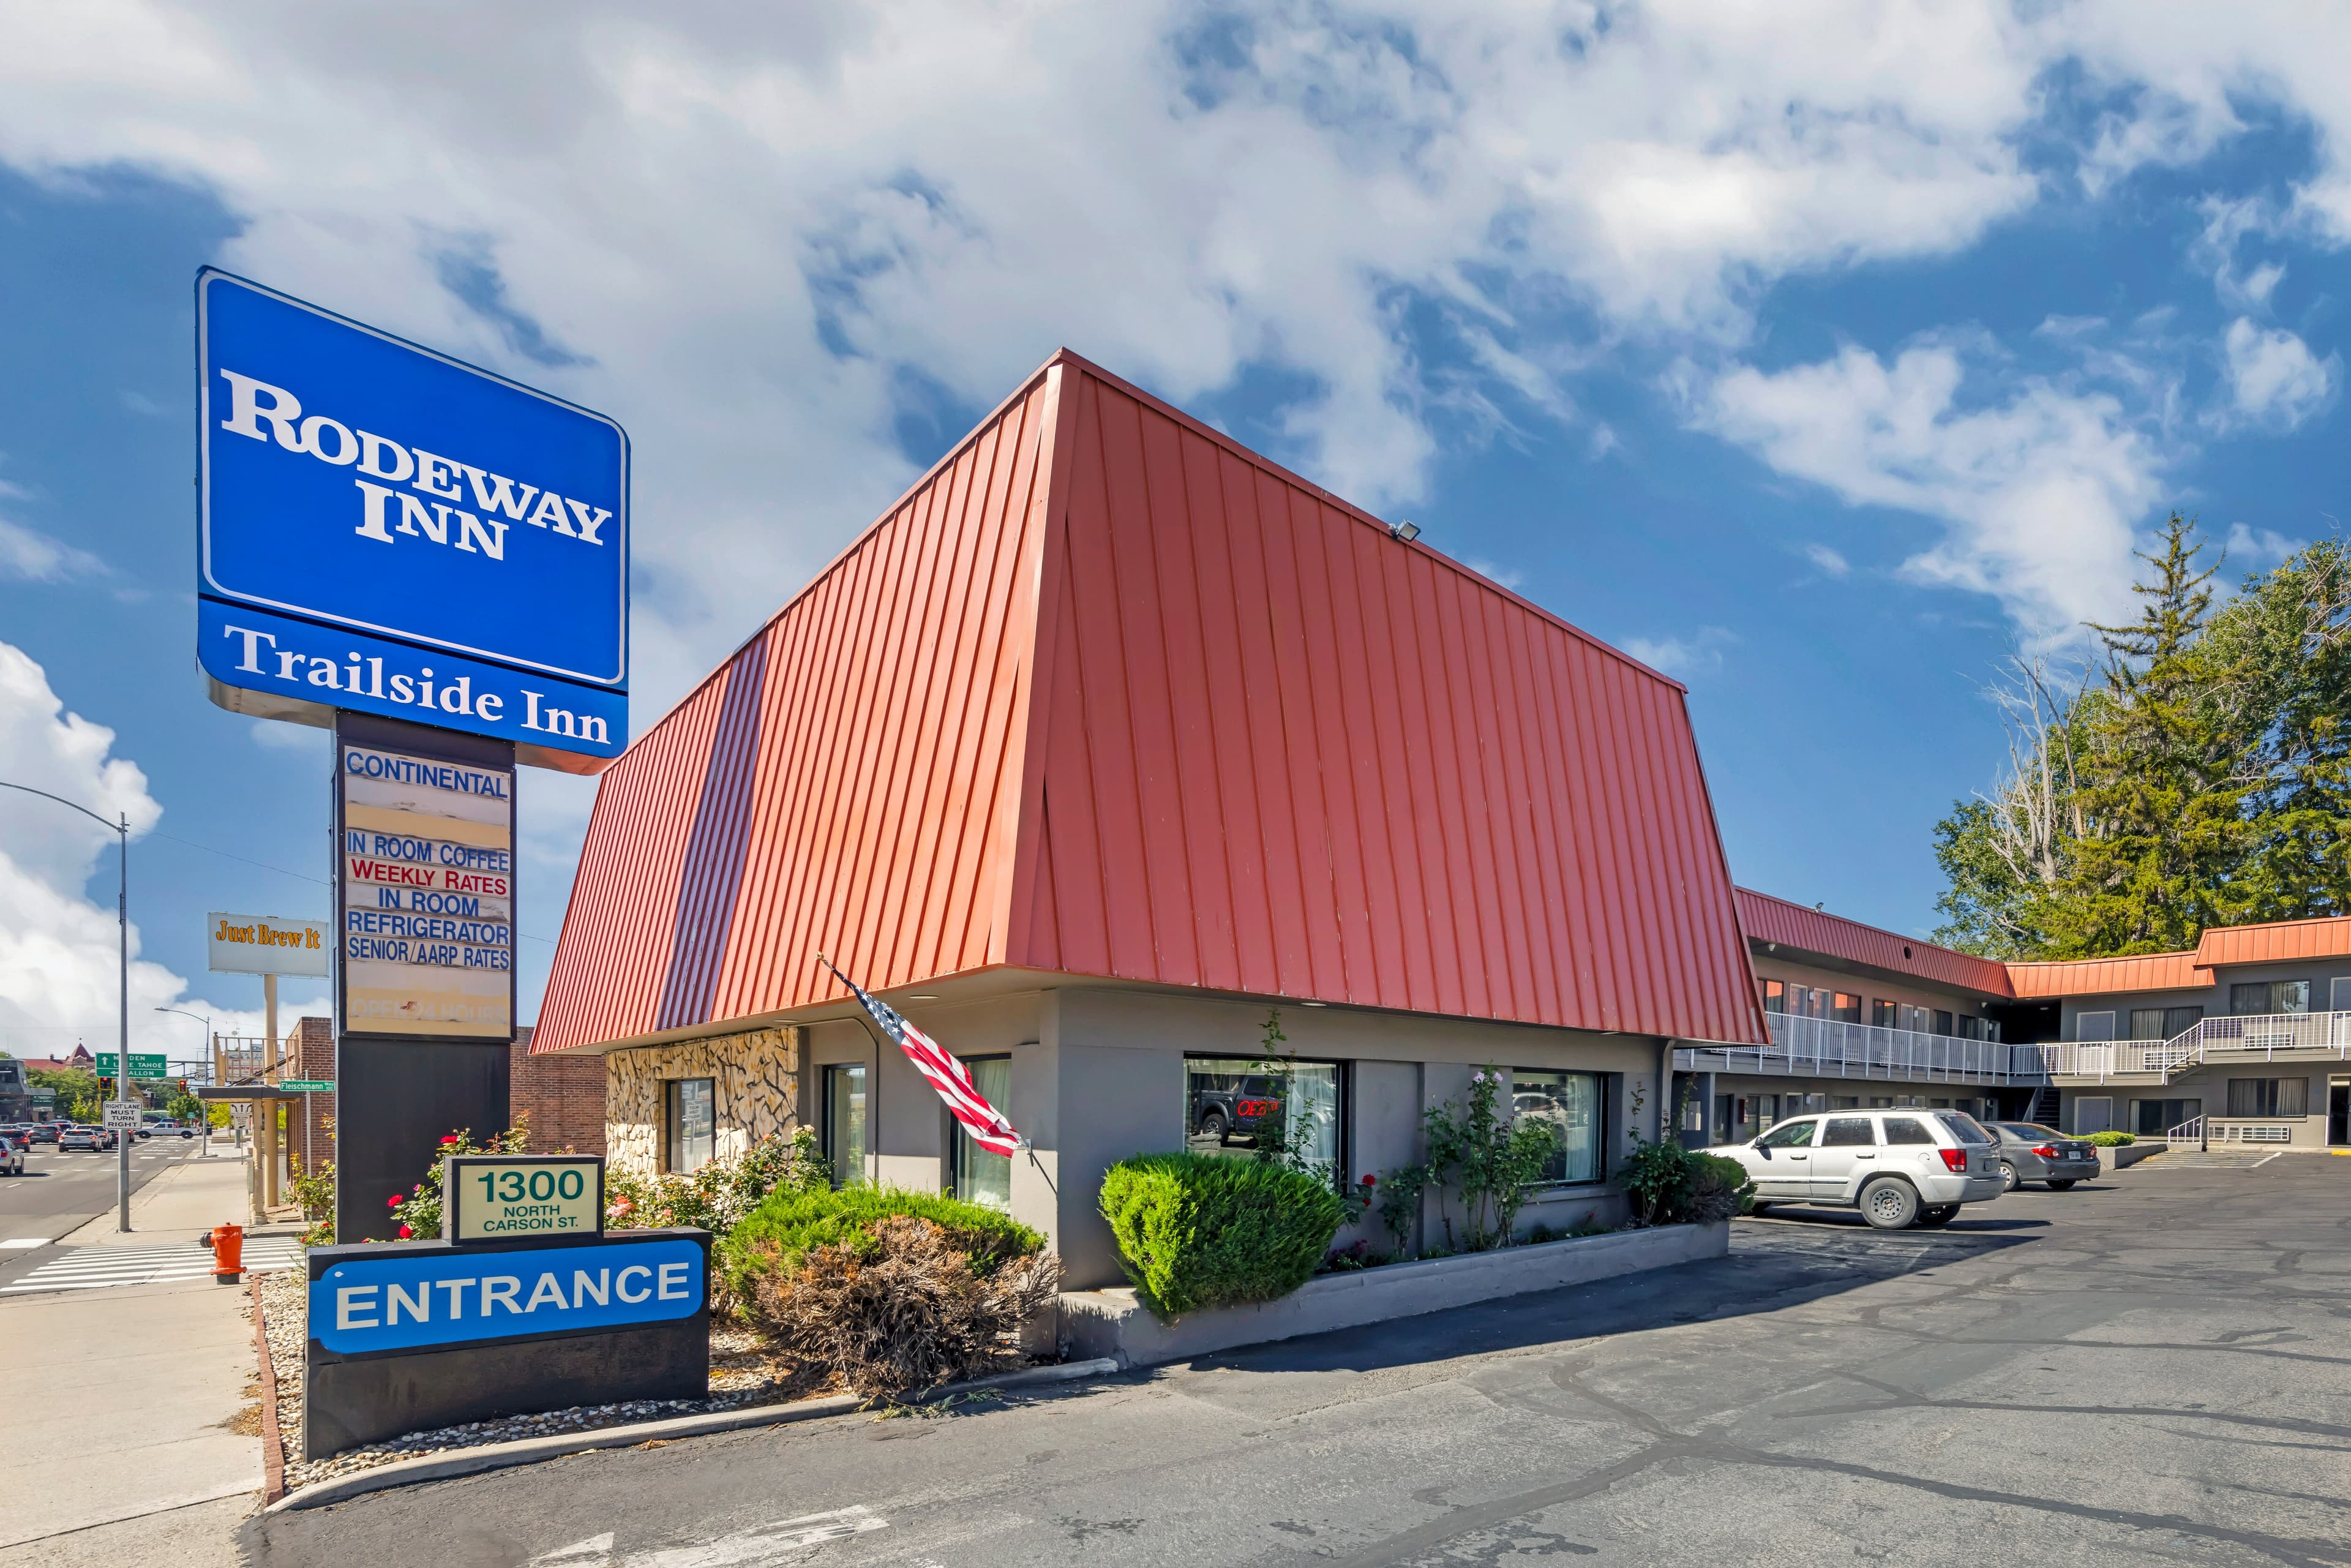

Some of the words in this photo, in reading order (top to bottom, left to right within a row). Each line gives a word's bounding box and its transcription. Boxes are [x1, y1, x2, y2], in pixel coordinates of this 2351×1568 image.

[220, 368, 613, 546] RODEWAY
[355, 479, 509, 561] INN
[224, 625, 504, 721] Trailside
[520, 690, 611, 745] Inn
[346, 751, 508, 798] CONTINENTAL
[347, 831, 366, 853] IN
[375, 836, 432, 862] ROOM
[440, 844, 509, 872] COFFEE
[351, 859, 435, 887] WEEKLY
[445, 870, 507, 895] RATES
[378, 888, 400, 909] IN
[411, 891, 479, 917] ROOM
[216, 920, 255, 944] Just
[258, 924, 303, 948] Brew
[305, 928, 320, 950] It
[348, 910, 509, 945] REFRIGERATOR
[348, 937, 458, 965] SENIOR/AARP
[463, 947, 509, 970] RATES
[477, 1169, 584, 1202] 1300
[483, 1217, 553, 1232] CARSON
[558, 1216, 578, 1228] ST.
[503, 1204, 560, 1218] NORTH
[337, 1262, 689, 1330] ENTRANCE
